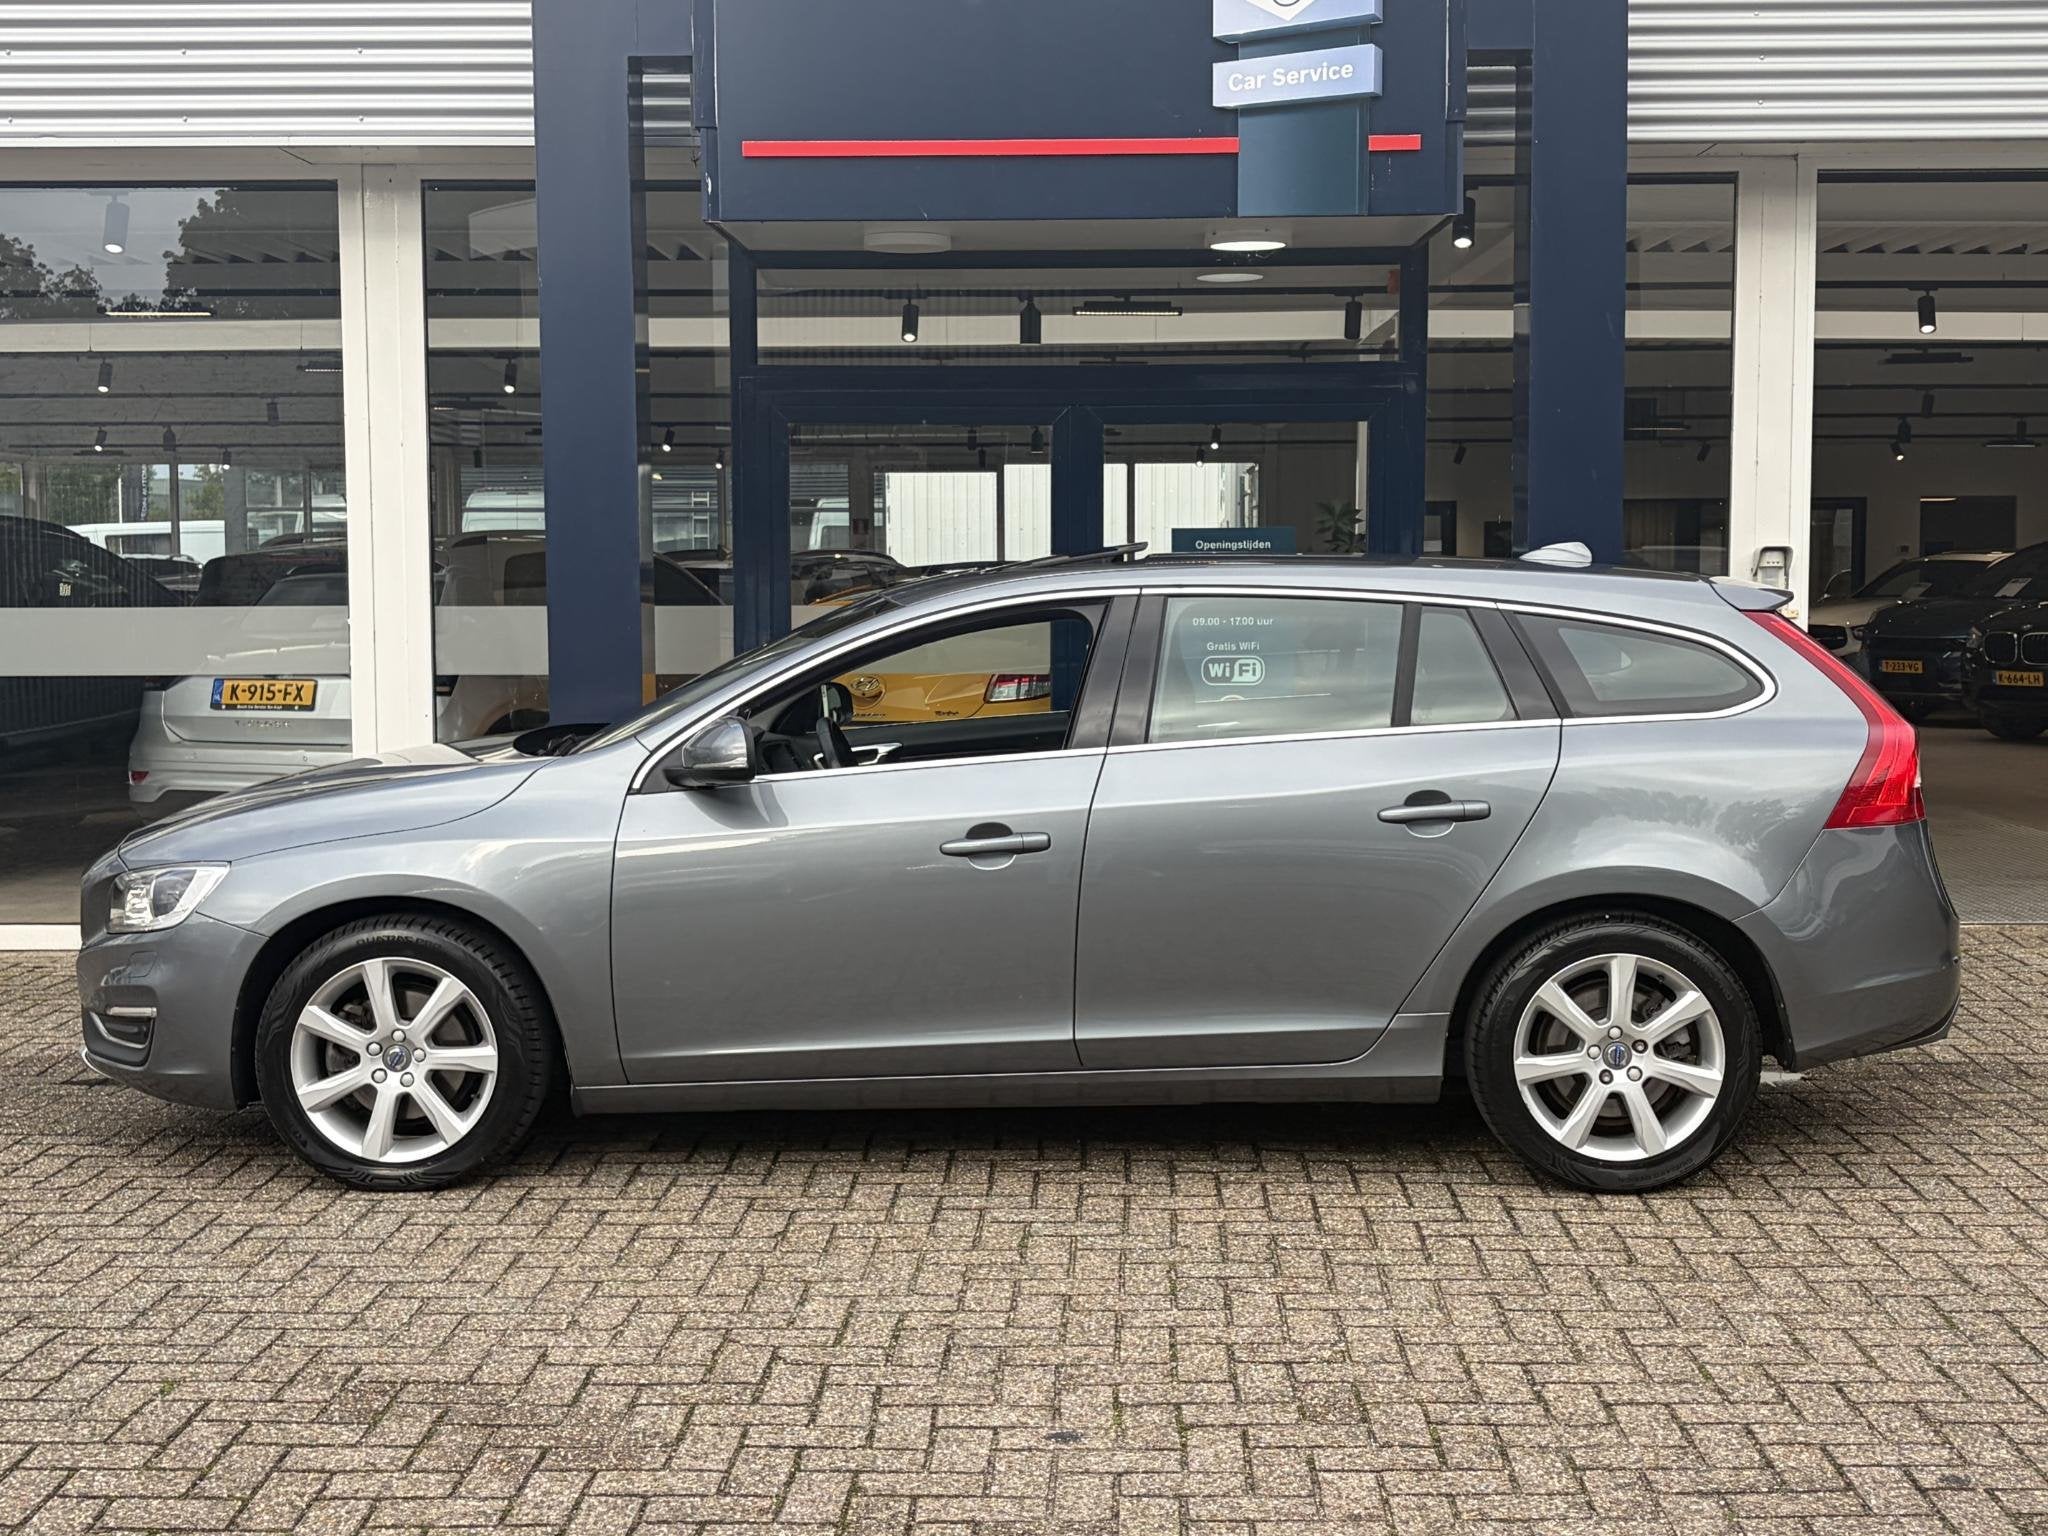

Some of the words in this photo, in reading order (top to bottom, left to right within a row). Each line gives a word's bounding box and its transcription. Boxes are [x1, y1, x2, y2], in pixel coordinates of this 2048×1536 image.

[1228, 73, 1266, 92] Car
[1272, 62, 1354, 87] Service
[1195, 540, 1271, 551] Openingstijden
[1192, 617, 1220, 626] 09.00
[1229, 617, 1255, 626] 17.00
[1256, 618, 1274, 626] uur
[1206, 642, 1237, 651] Gratis
[1238, 641, 1260, 651] WiFi
[1998, 672, 2041, 685] K-664-LH
[229, 683, 304, 702] K-915-FX
